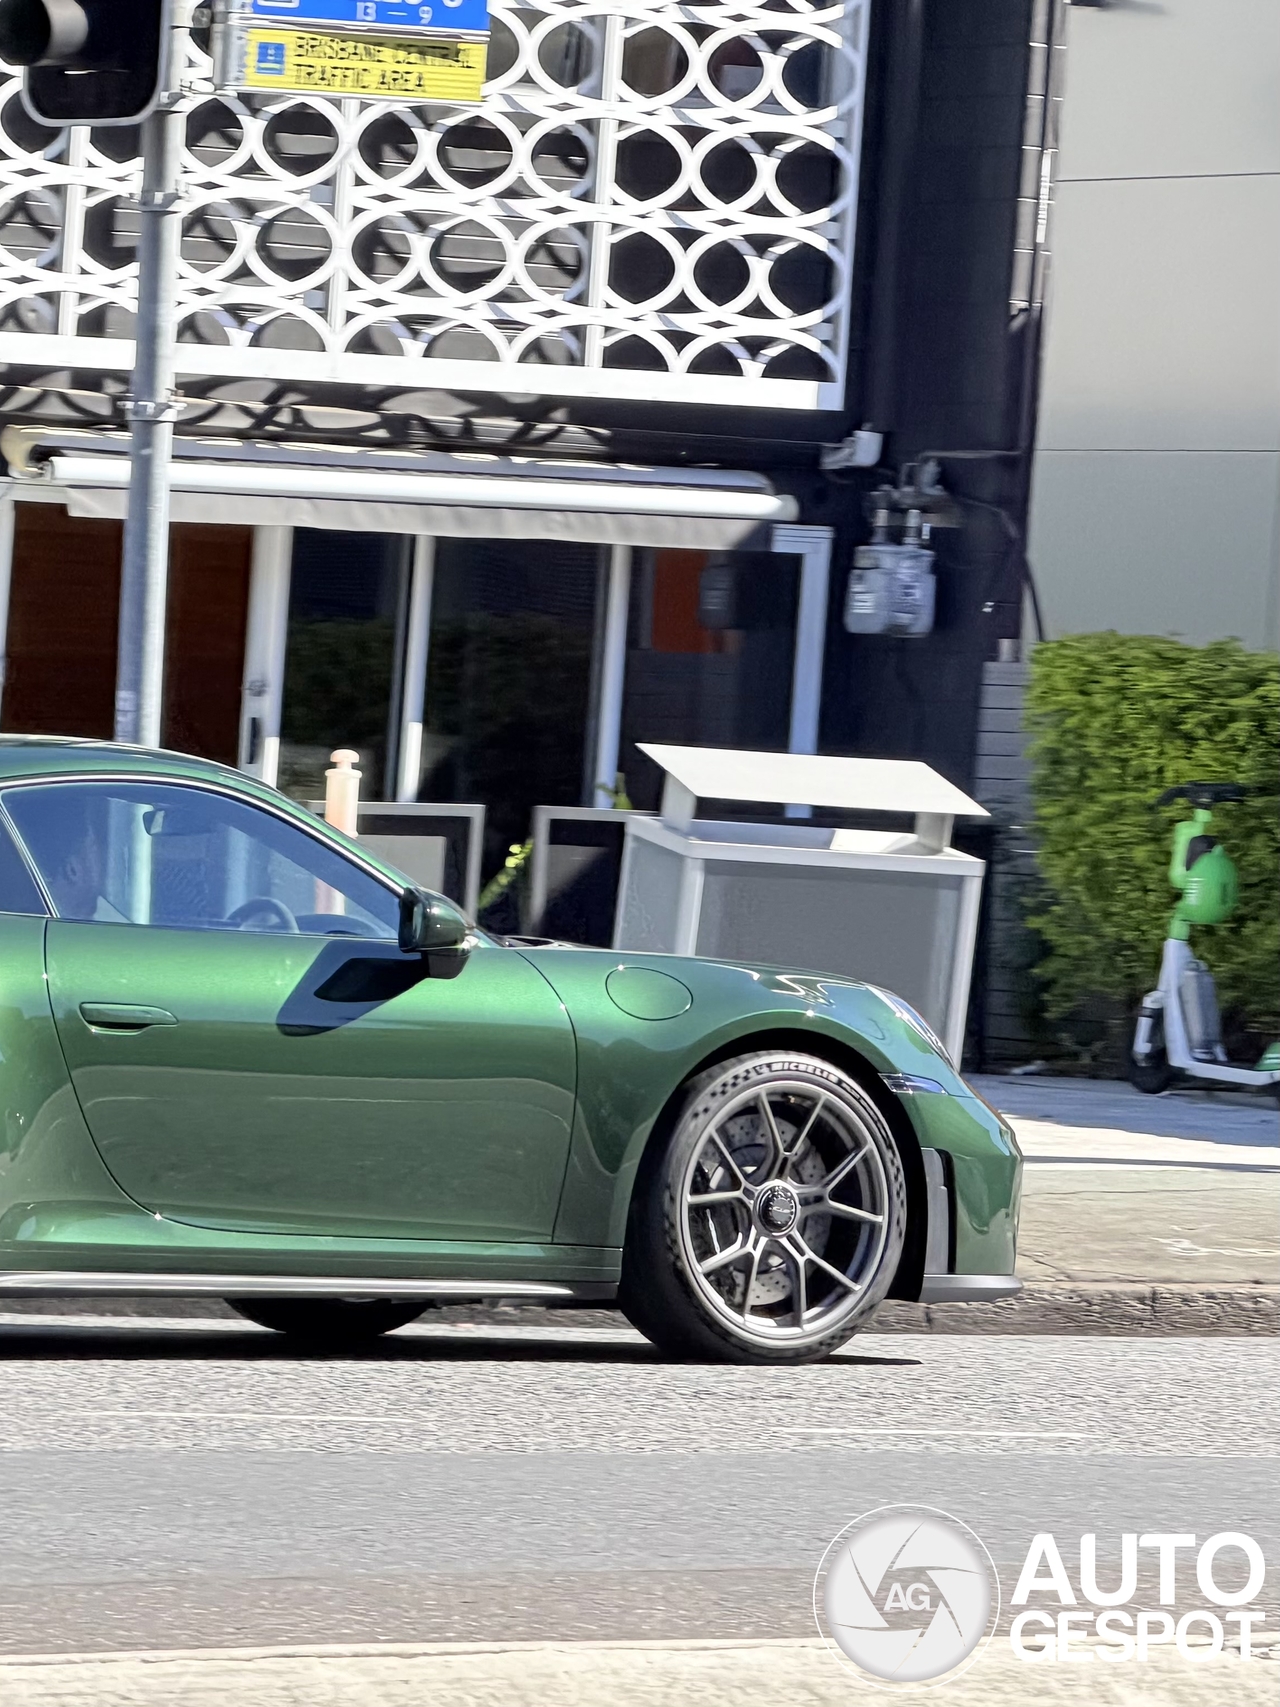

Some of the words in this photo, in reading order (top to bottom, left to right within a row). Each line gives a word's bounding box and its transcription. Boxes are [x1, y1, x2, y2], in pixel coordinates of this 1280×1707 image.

[356, 1, 376, 21] 13
[418, 6, 433, 24] 9
[294, 36, 388, 63] BRISBANE
[393, 43, 476, 69] CENTRAL
[293, 63, 370, 89] TRAFFIC
[375, 69, 427, 93] AREA
[771, 1061, 840, 1084] MICHELIN
